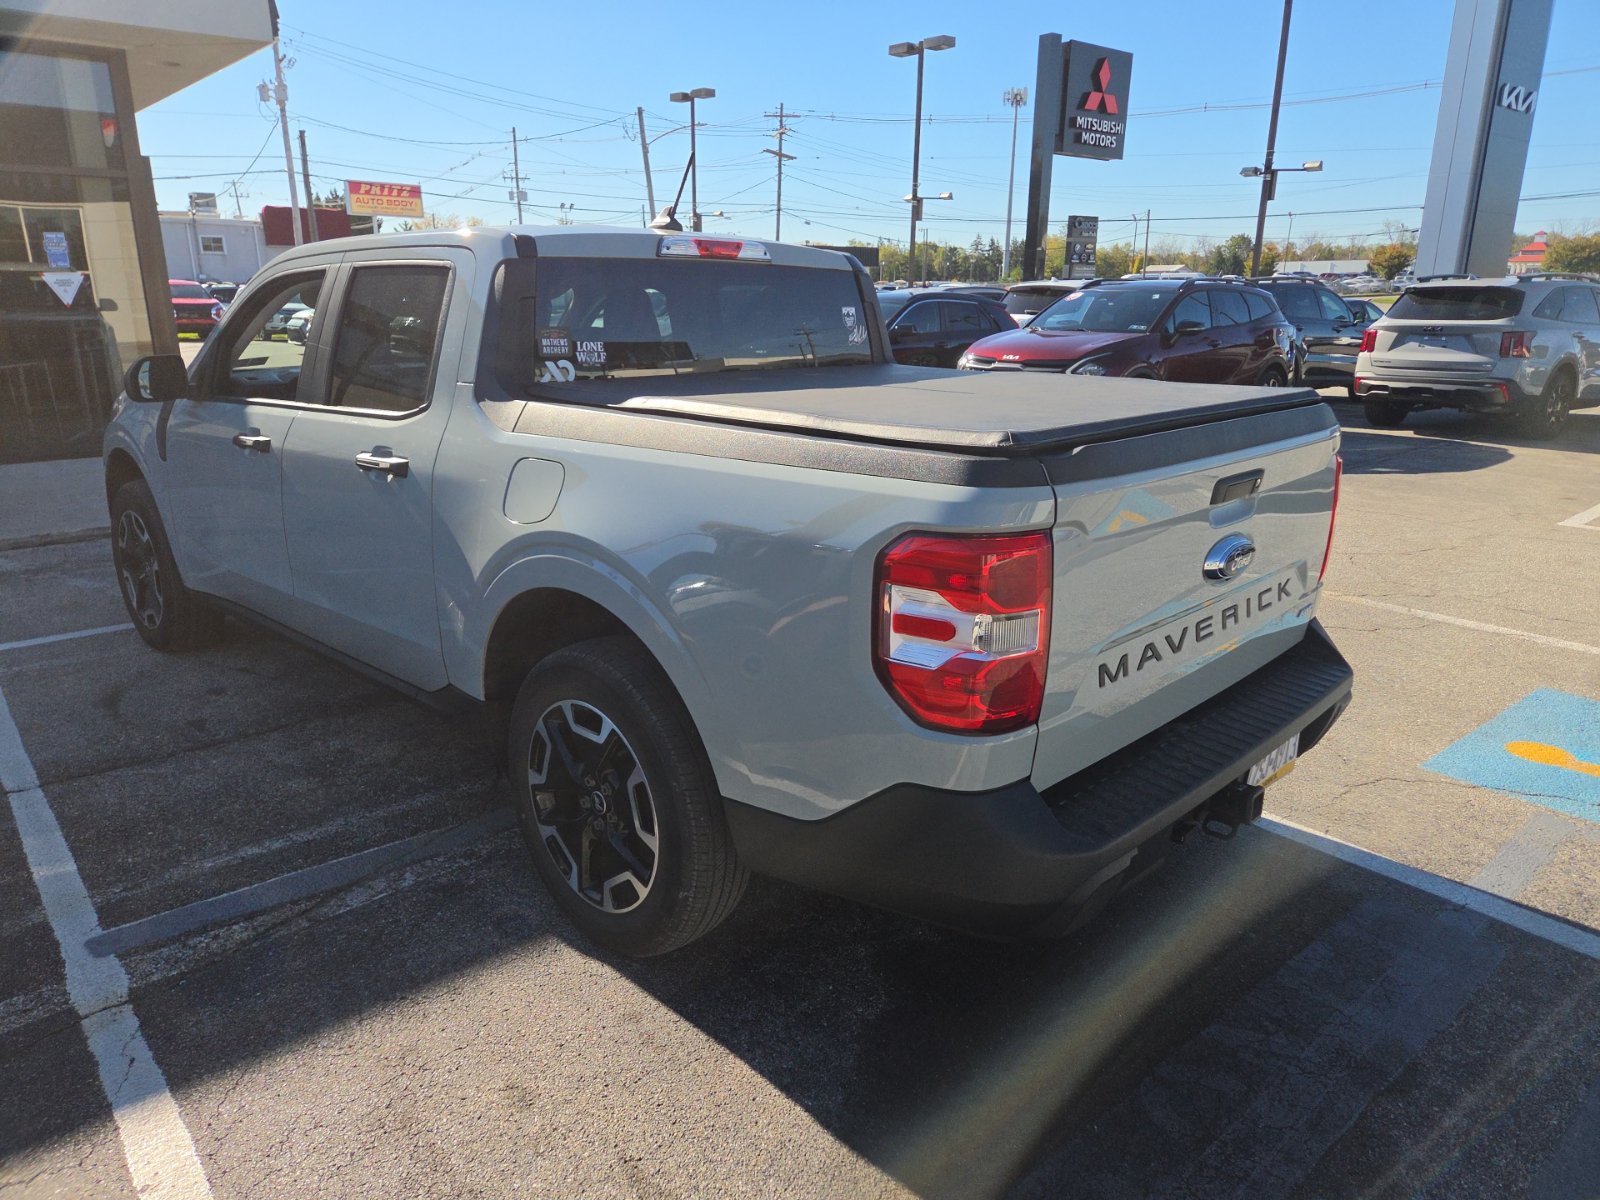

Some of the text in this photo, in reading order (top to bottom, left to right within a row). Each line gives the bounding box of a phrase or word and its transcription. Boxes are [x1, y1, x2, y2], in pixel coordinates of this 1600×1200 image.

[1501, 81, 1538, 114] KIA
[1076, 116, 1124, 135] MITSUBISHI
[1081, 132, 1117, 148] MOTORS
[359, 183, 412, 197] PRITZ
[355, 197, 414, 207] AUTO BODY
[541, 338, 568, 346] MATHEWS
[576, 341, 605, 352] LONE
[543, 346, 569, 354] ARCHERY
[1098, 577, 1292, 688] MAVERICK
